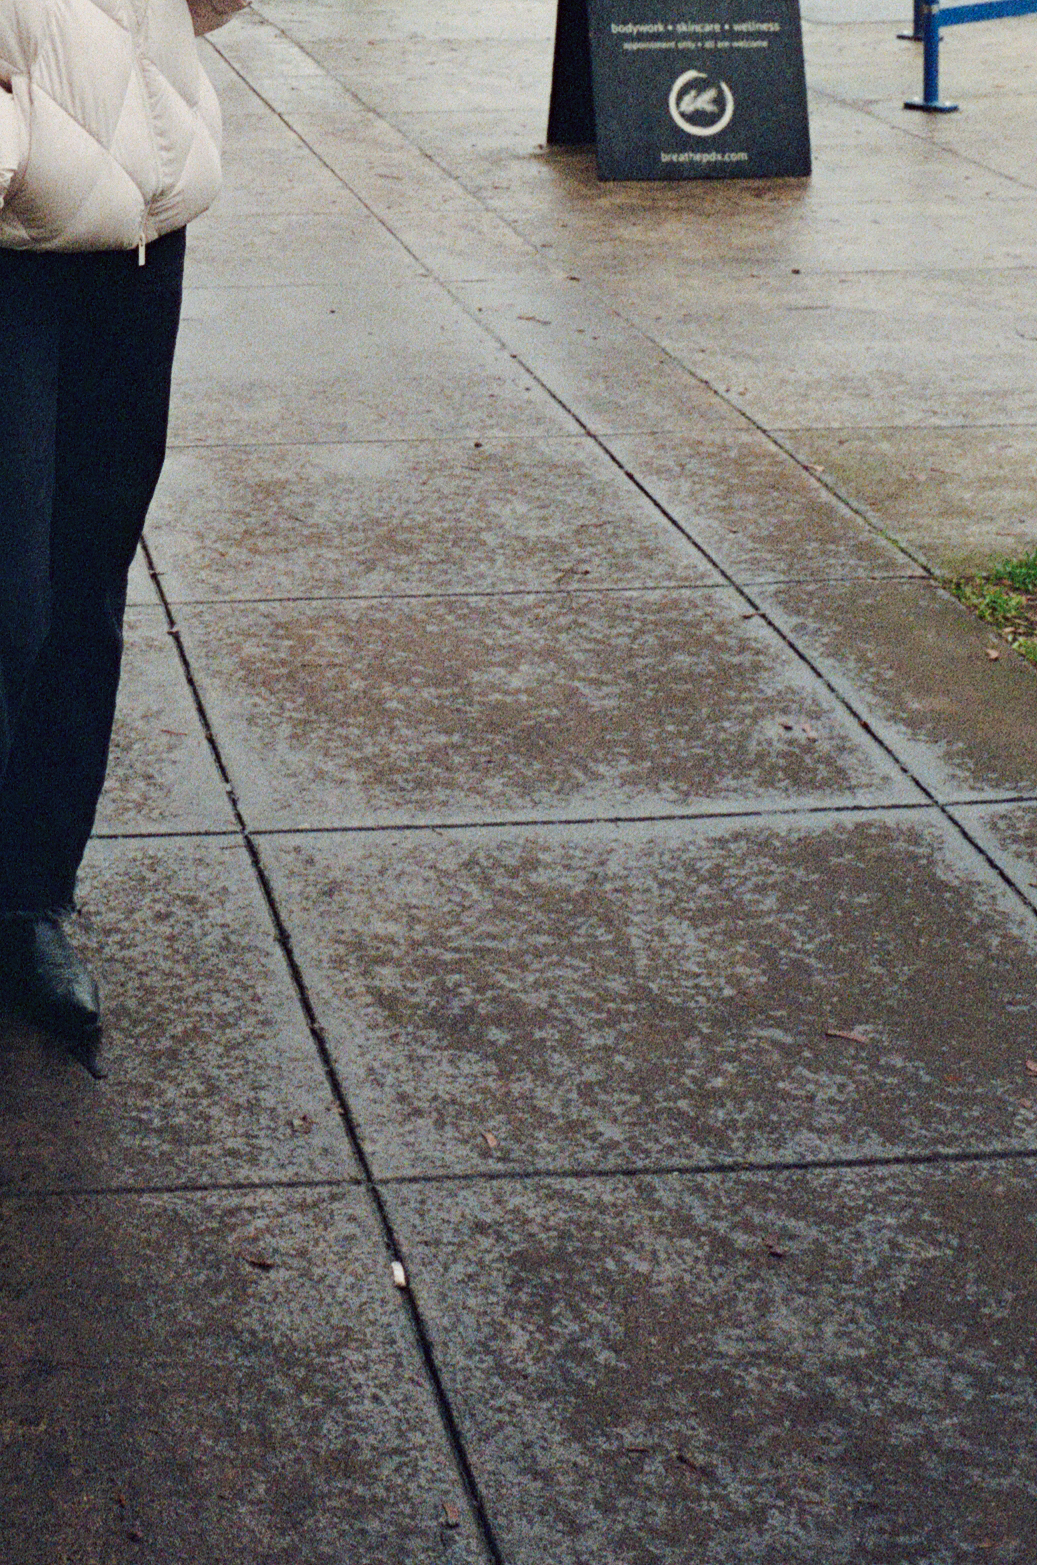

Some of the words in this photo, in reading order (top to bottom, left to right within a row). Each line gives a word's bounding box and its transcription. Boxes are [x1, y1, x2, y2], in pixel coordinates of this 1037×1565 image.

[611, 22, 664, 35] bodywork
[676, 21, 721, 33] skincare
[732, 21, 781, 32] wellness
